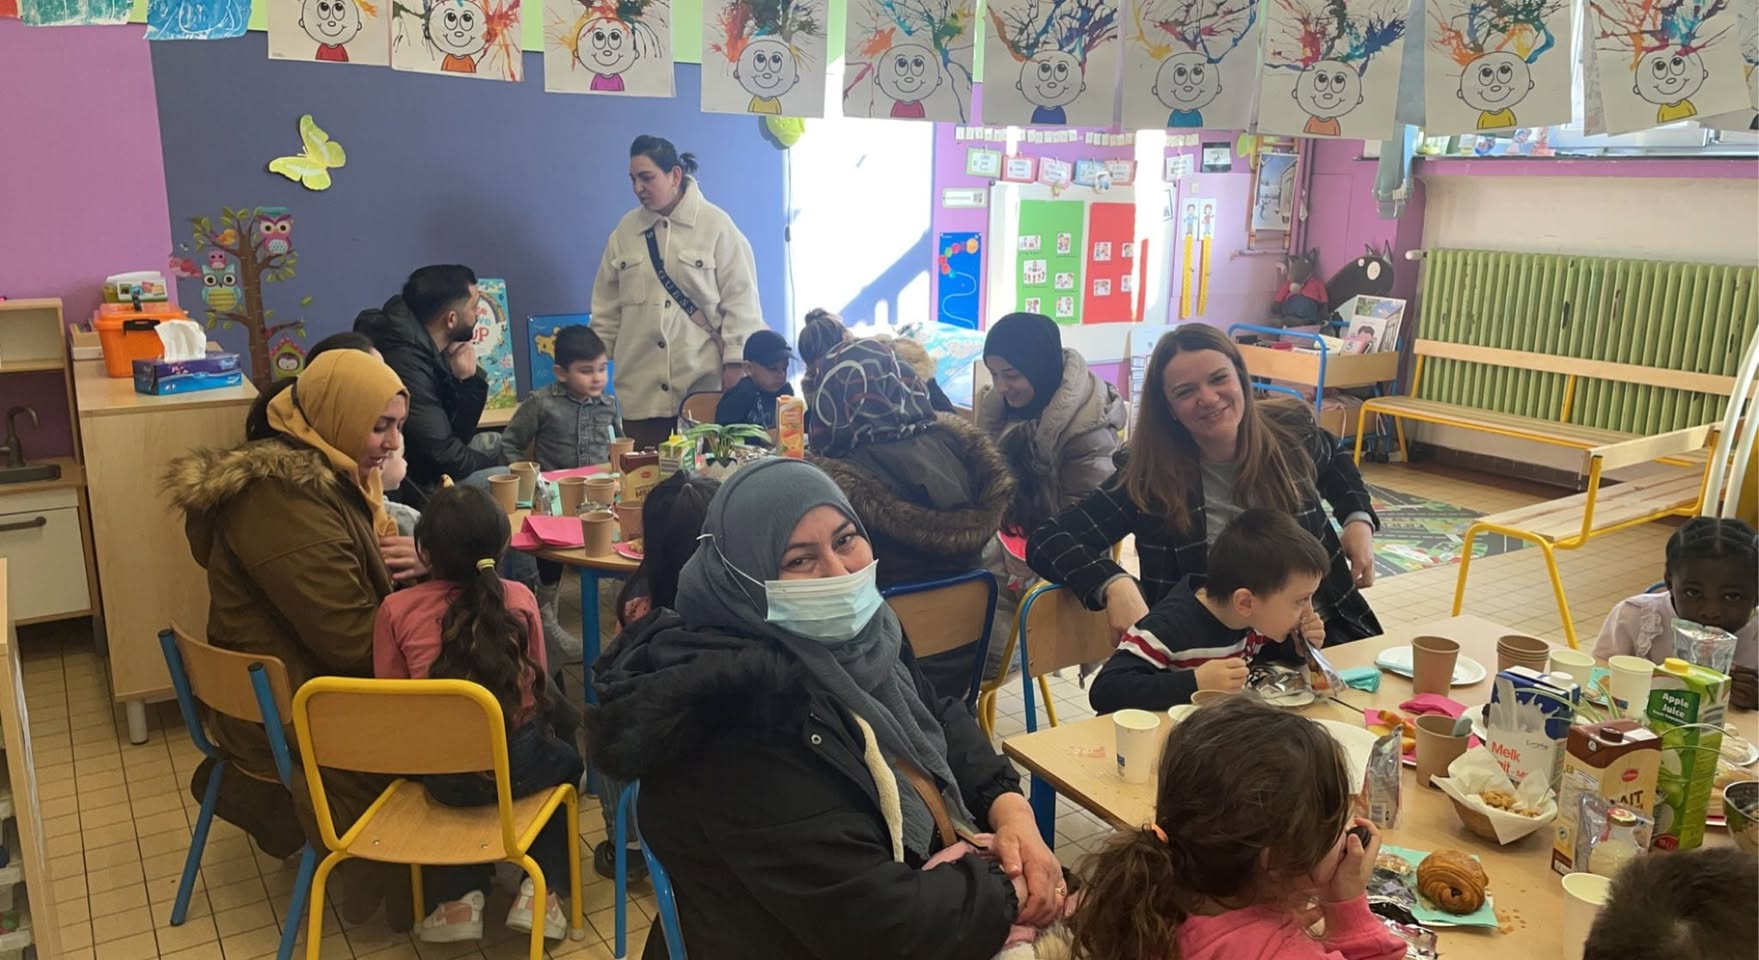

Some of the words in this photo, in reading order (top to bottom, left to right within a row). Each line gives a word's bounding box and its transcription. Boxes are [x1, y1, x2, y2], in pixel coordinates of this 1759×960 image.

[1662, 692, 1689, 709] Apple
[1662, 703, 1686, 719] Juice
[1492, 741, 1521, 763] Melk
[1611, 789, 1644, 806] AIT
